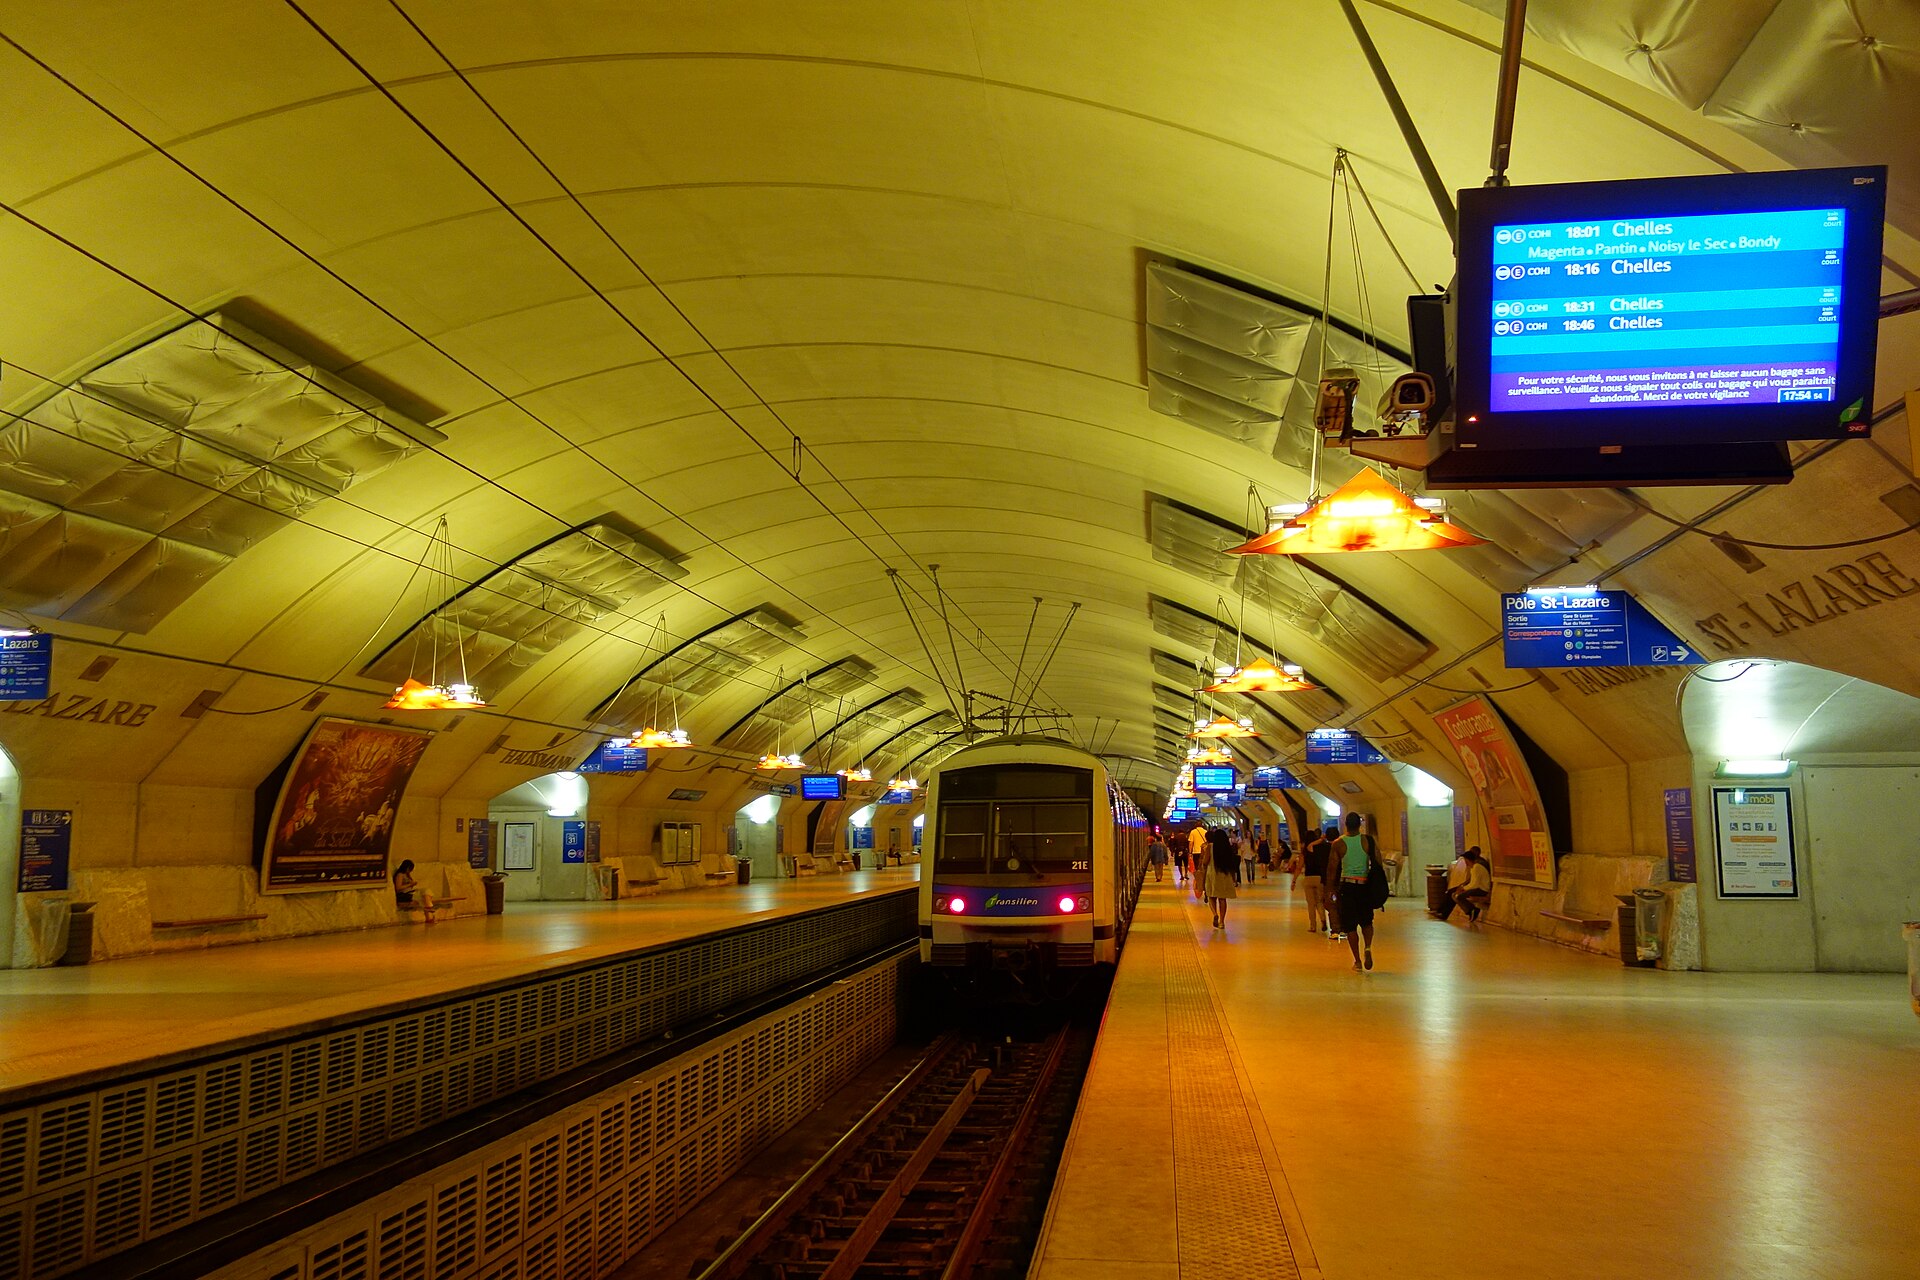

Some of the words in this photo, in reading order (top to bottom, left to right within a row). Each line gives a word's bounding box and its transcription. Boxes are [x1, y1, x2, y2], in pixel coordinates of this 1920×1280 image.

[1565, 225, 1600, 238] 18:01
[1612, 221, 1673, 237] Chelles
[1528, 246, 1584, 260] Magenta
[1595, 242, 1637, 255] Pantin
[1648, 240, 1685, 254] Noisy
[1688, 239, 1701, 251] le
[1704, 238, 1728, 250] Sec
[1738, 235, 1781, 250] Bondy
[1565, 263, 1600, 276] 18:16
[1611, 259, 1672, 275] Chelles
[1821, 258, 1840, 266] court
[1563, 301, 1595, 313] 18:31
[1610, 298, 1664, 312] Chelles
[1563, 319, 1595, 331] 18:46
[1609, 316, 1663, 330] Chelles
[1518, 376, 1539, 386] Pour
[1541, 376, 1564, 385] votre
[1565, 373, 1604, 384] sécurité,
[1606, 374, 1627, 383] nous
[1629, 374, 1650, 382] vous
[1651, 371, 1687, 381] invitons
[1689, 369, 1695, 379] à
[1697, 371, 1709, 379] ne
[1710, 368, 1739, 378] laisser
[1740, 369, 1769, 377] aucun
[1770, 367, 1804, 377] bagage
[1805, 367, 1826, 375] sans
[1508, 387, 1562, 396] surveillance.
[1564, 385, 1599, 394] Veuillez
[1601, 385, 1623, 393] nous
[1624, 383, 1659, 393] signaler
[1660, 382, 1680, 391] tout
[1682, 380, 1703, 390] colis
[1705, 381, 1717, 389] ou
[1719, 379, 1751, 390] bagage
[1753, 377, 1768, 388] qui
[1770, 378, 1791, 387] vous
[1589, 393, 1642, 403] abandonné.
[1643, 392, 1668, 401] Merci
[1670, 391, 1682, 400] de
[1684, 391, 1708, 400] votre
[1710, 390, 1750, 401] vigilance
[1783, 391, 1812, 400] 17:54
[1506, 597, 1536, 610] Pôle
[1541, 595, 1610, 609] St-Lazare
[1444, 712, 1496, 740] Conforama
[1071, 861, 1089, 870] 21E
[990, 897, 1038, 907] Transilien
